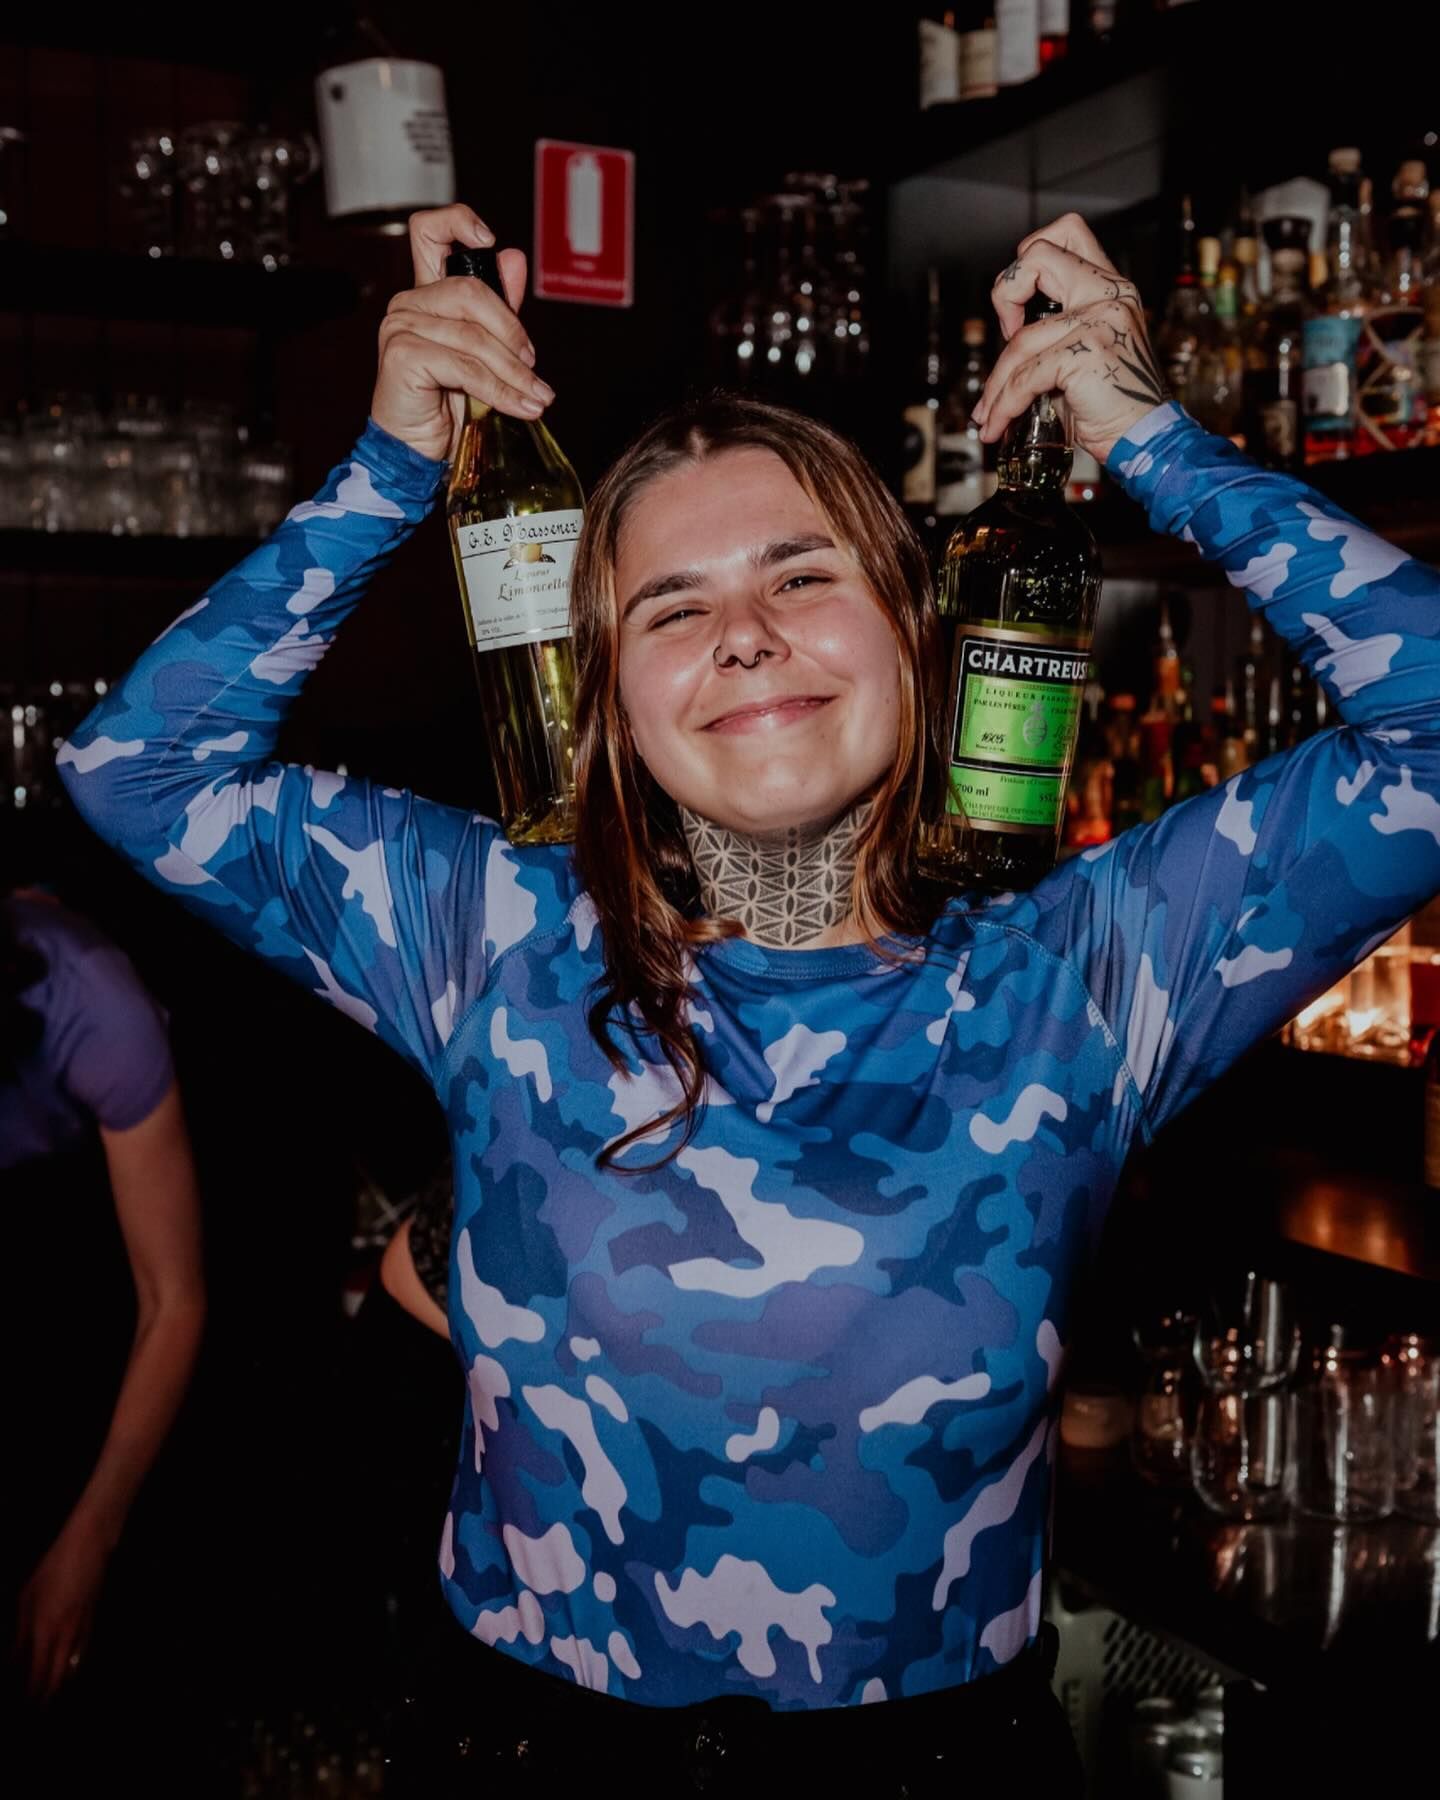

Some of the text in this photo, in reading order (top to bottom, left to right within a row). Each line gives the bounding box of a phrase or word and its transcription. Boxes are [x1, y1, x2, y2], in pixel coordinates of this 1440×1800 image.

[968, 648, 1089, 680] CHARTREUS
[986, 687, 1036, 700] LIQUEUR
[956, 783, 989, 797] 700 ml
